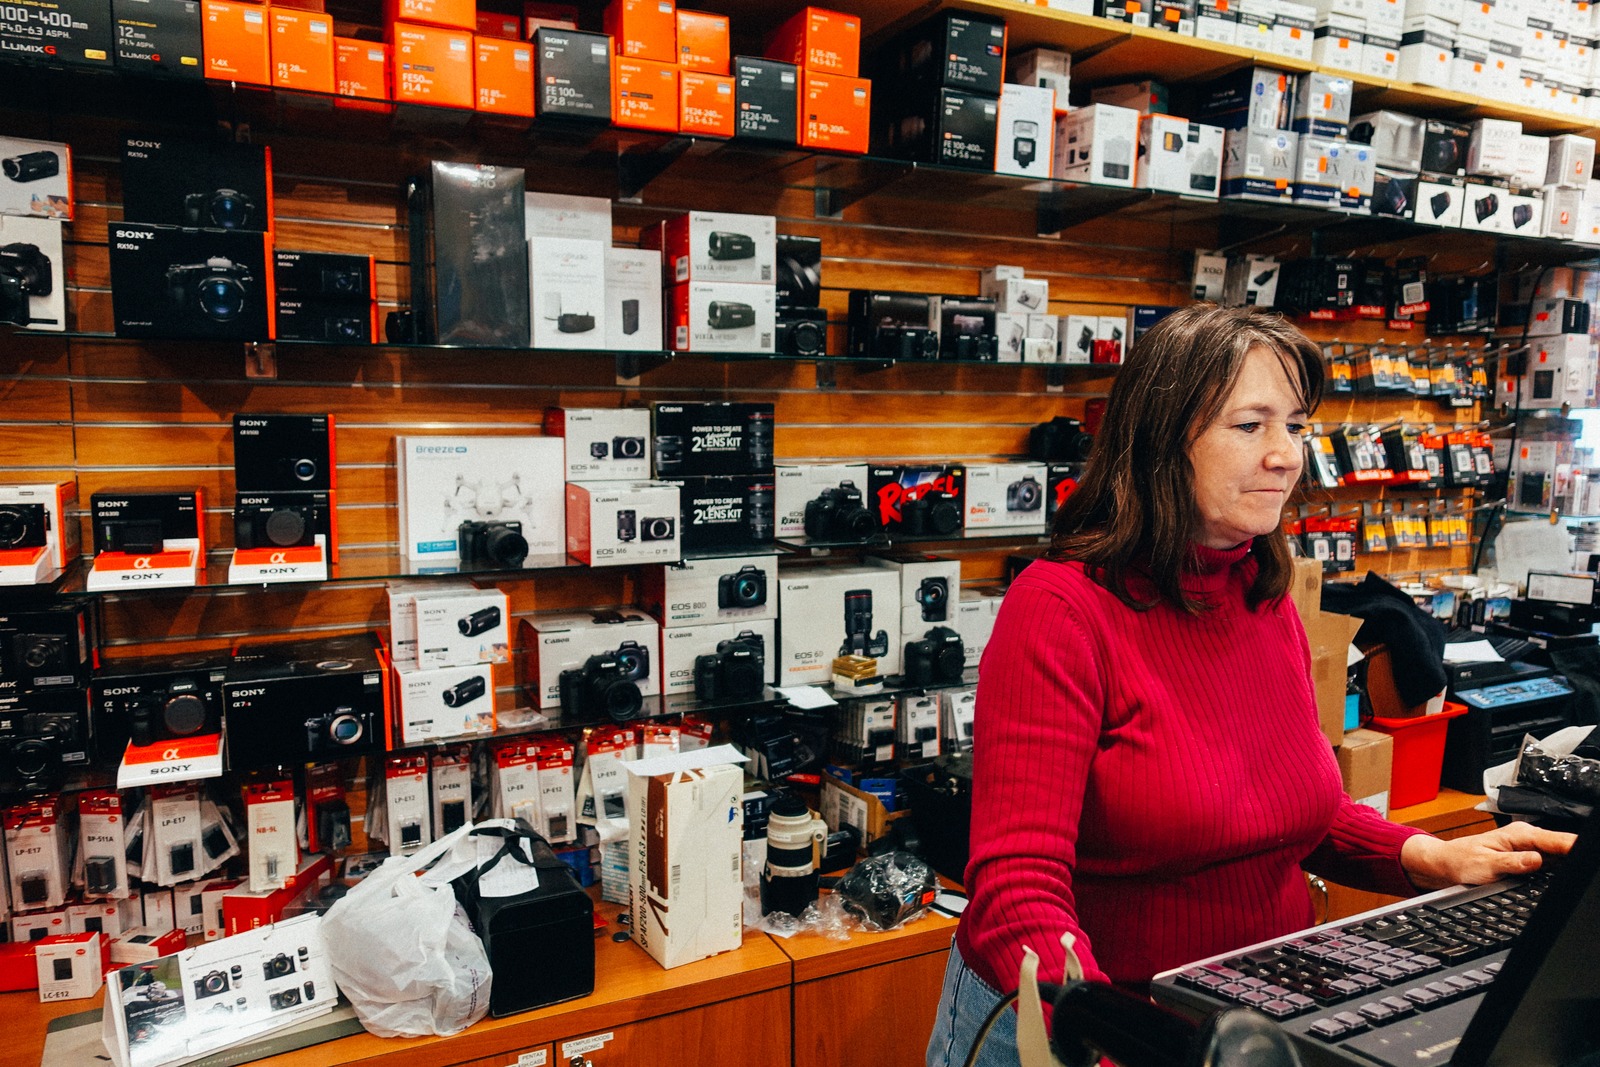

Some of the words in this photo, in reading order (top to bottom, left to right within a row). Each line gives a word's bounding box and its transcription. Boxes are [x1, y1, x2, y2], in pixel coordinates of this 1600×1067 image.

[46, 29, 72, 39] ASPH.
[118, 25, 147, 39] 12mm
[401, 32, 425, 40] SONY
[545, 37, 568, 46] SONY
[1, 40, 44, 53] LUMIX
[120, 50, 151, 60] LUMIX
[211, 58, 228, 67] 1.4X
[546, 85, 557, 95] FE
[546, 95, 565, 106] F2.8
[127, 139, 162, 150] SONY
[116, 229, 155, 240] SONY
[692, 437, 702, 452] 2
[701, 437, 726, 447] LENS
[727, 437, 742, 447] KIT
[416, 445, 455, 454] Breeze
[693, 509, 703, 525] 2
[702, 509, 727, 519] LENS
[727, 509, 743, 519] KIT
[596, 548, 615, 556] EOS
[259, 567, 298, 575] SONY
[121, 573, 164, 581] SONY
[671, 603, 691, 611] EOS
[693, 602, 707, 610] 80D
[669, 632, 692, 640] Canon
[544, 637, 570, 645] Canon
[104, 687, 140, 695] SONY
[232, 689, 265, 698] SONY
[150, 764, 192, 775] SONY
[162, 816, 186, 827] LP-E17
[16, 847, 41, 856] LP-E17
[43, 991, 69, 999] LC-E12
[566, 1039, 591, 1049] OLYMPUS
[522, 1052, 544, 1061] PENTAX
